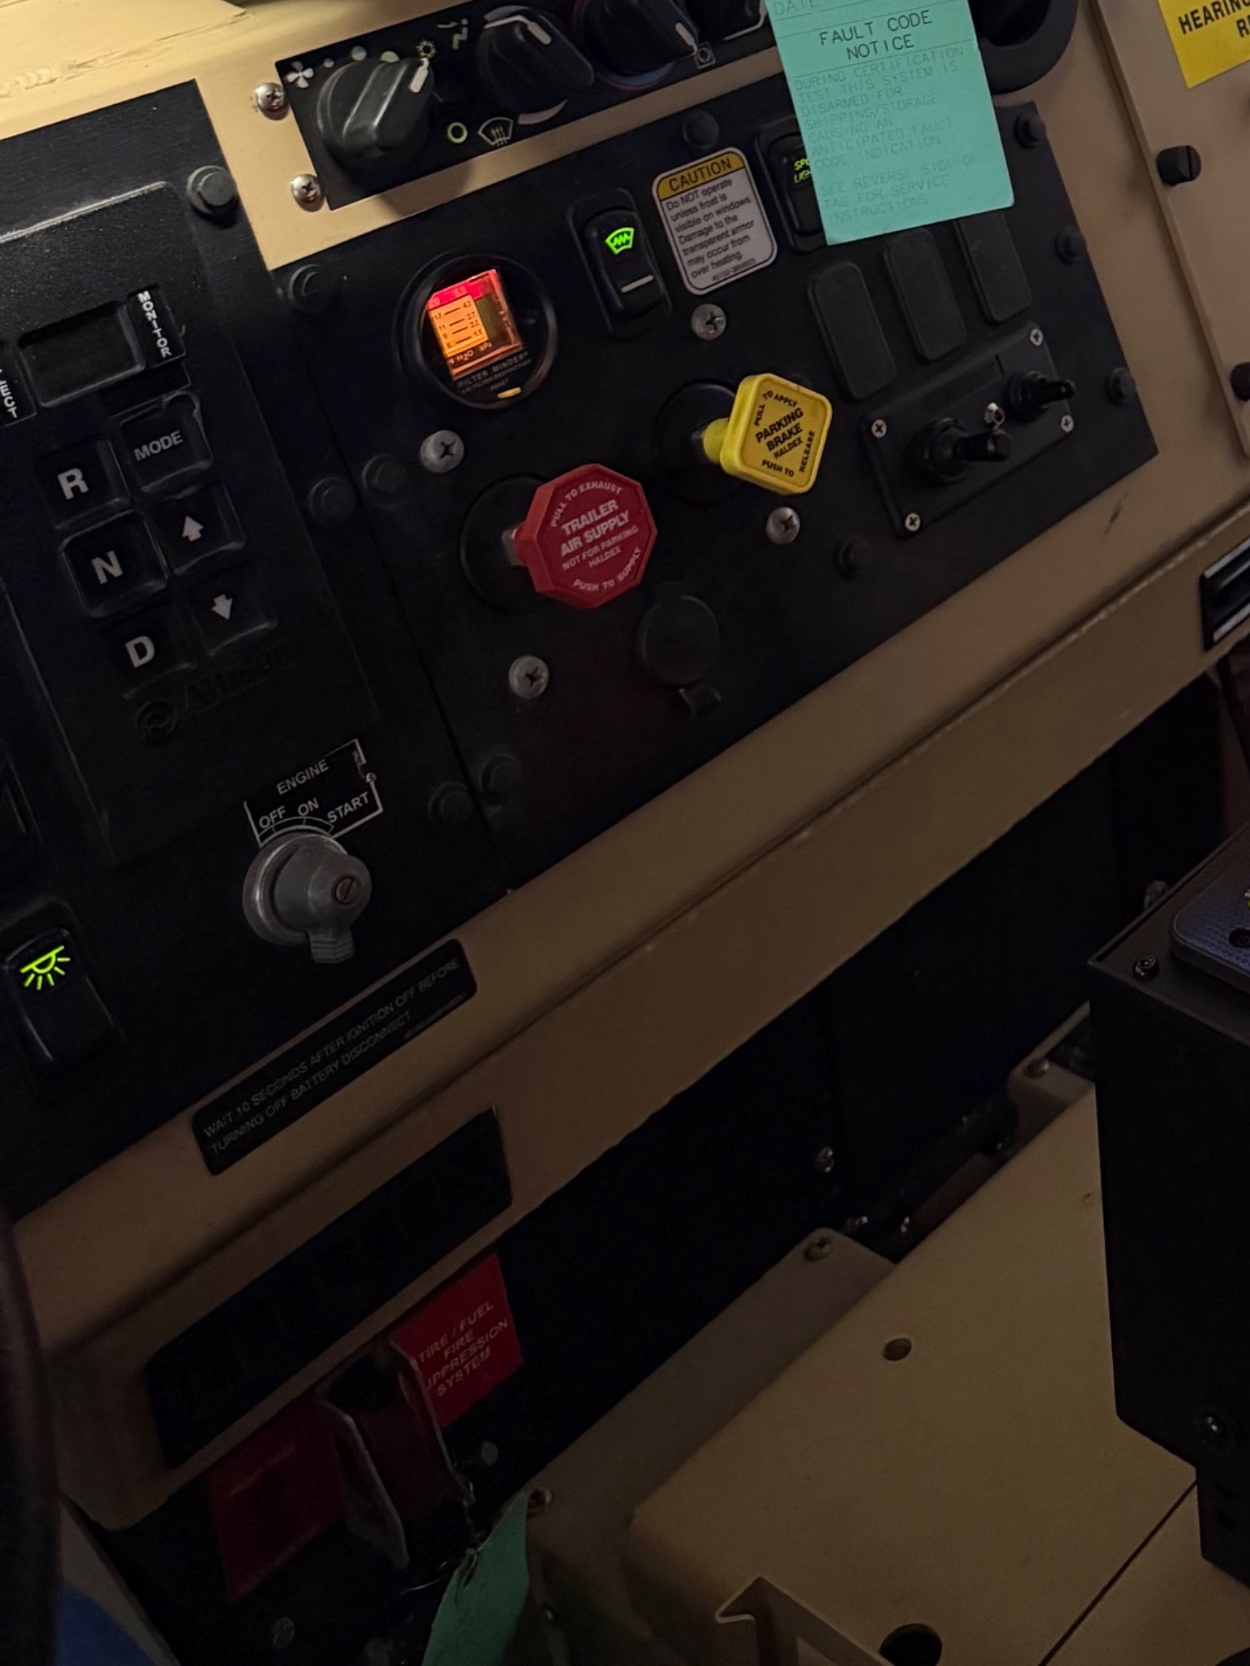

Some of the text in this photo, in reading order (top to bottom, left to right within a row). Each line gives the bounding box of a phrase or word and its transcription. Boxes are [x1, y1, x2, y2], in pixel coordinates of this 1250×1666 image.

[819, 9, 932, 47] FAULT CODE
[846, 34, 914, 61] NOTICE
[794, 45, 964, 91] DURING CERTIFICATION
[798, 61, 958, 104] TEST THIS SYSTEM IS
[800, 87, 903, 118] DISARMED FOR
[805, 94, 937, 132] SHIPPING/STORAGE
[669, 158, 731, 191] CAUTION
[667, 179, 732, 210] Do NOT operate
[671, 193, 727, 222] unless frost is
[674, 213, 713, 232] visible on
[678, 225, 714, 245] Damage
[725, 215, 737, 224] the
[683, 220, 754, 256] transparent armor
[687, 235, 750, 268] may occur from
[691, 265, 708, 278] over
[137, 290, 172, 358] MONITOR
[457, 370, 489, 388] FILTER
[754, 390, 798, 426] PULL TO APPLY
[755, 407, 804, 444] PARKING
[133, 432, 184, 462] MODE
[761, 431, 815, 478] PUSH TO RELEASE
[766, 424, 803, 453] BRAKE
[773, 438, 804, 459] HALDEX
[57, 468, 88, 499] R
[551, 480, 623, 527] PULL TO EXHAUST
[562, 499, 619, 535] TRAILER
[560, 509, 630, 557] AIR SUPPLY
[562, 525, 639, 570] NOT FOR PARKING
[91, 550, 123, 585] N
[573, 547, 641, 592] PUSH TO SUPPLY
[588, 545, 622, 569] HALDEX
[126, 635, 154, 667] D
[276, 759, 329, 795] ENGINE
[259, 792, 371, 830] OFF ON START
[205, 1112, 234, 1136] WAIT
[237, 1103, 249, 1114] 10
[252, 1063, 307, 1105] SECONDS
[310, 1037, 345, 1065] AFTER
[347, 1005, 393, 1040] IGNITION
[396, 988, 418, 1006] OFF
[419, 959, 459, 990] BEFORE
[212, 1114, 264, 1152] TURNING
[266, 1098, 288, 1116] OFF
[290, 1062, 339, 1099] BATTERY
[341, 1012, 411, 1064] DISCONNECT
[419, 1301, 494, 1362] TIRE FUEL
[444, 1330, 474, 1360] FIRE
[437, 1345, 491, 1396] SYSTEM
